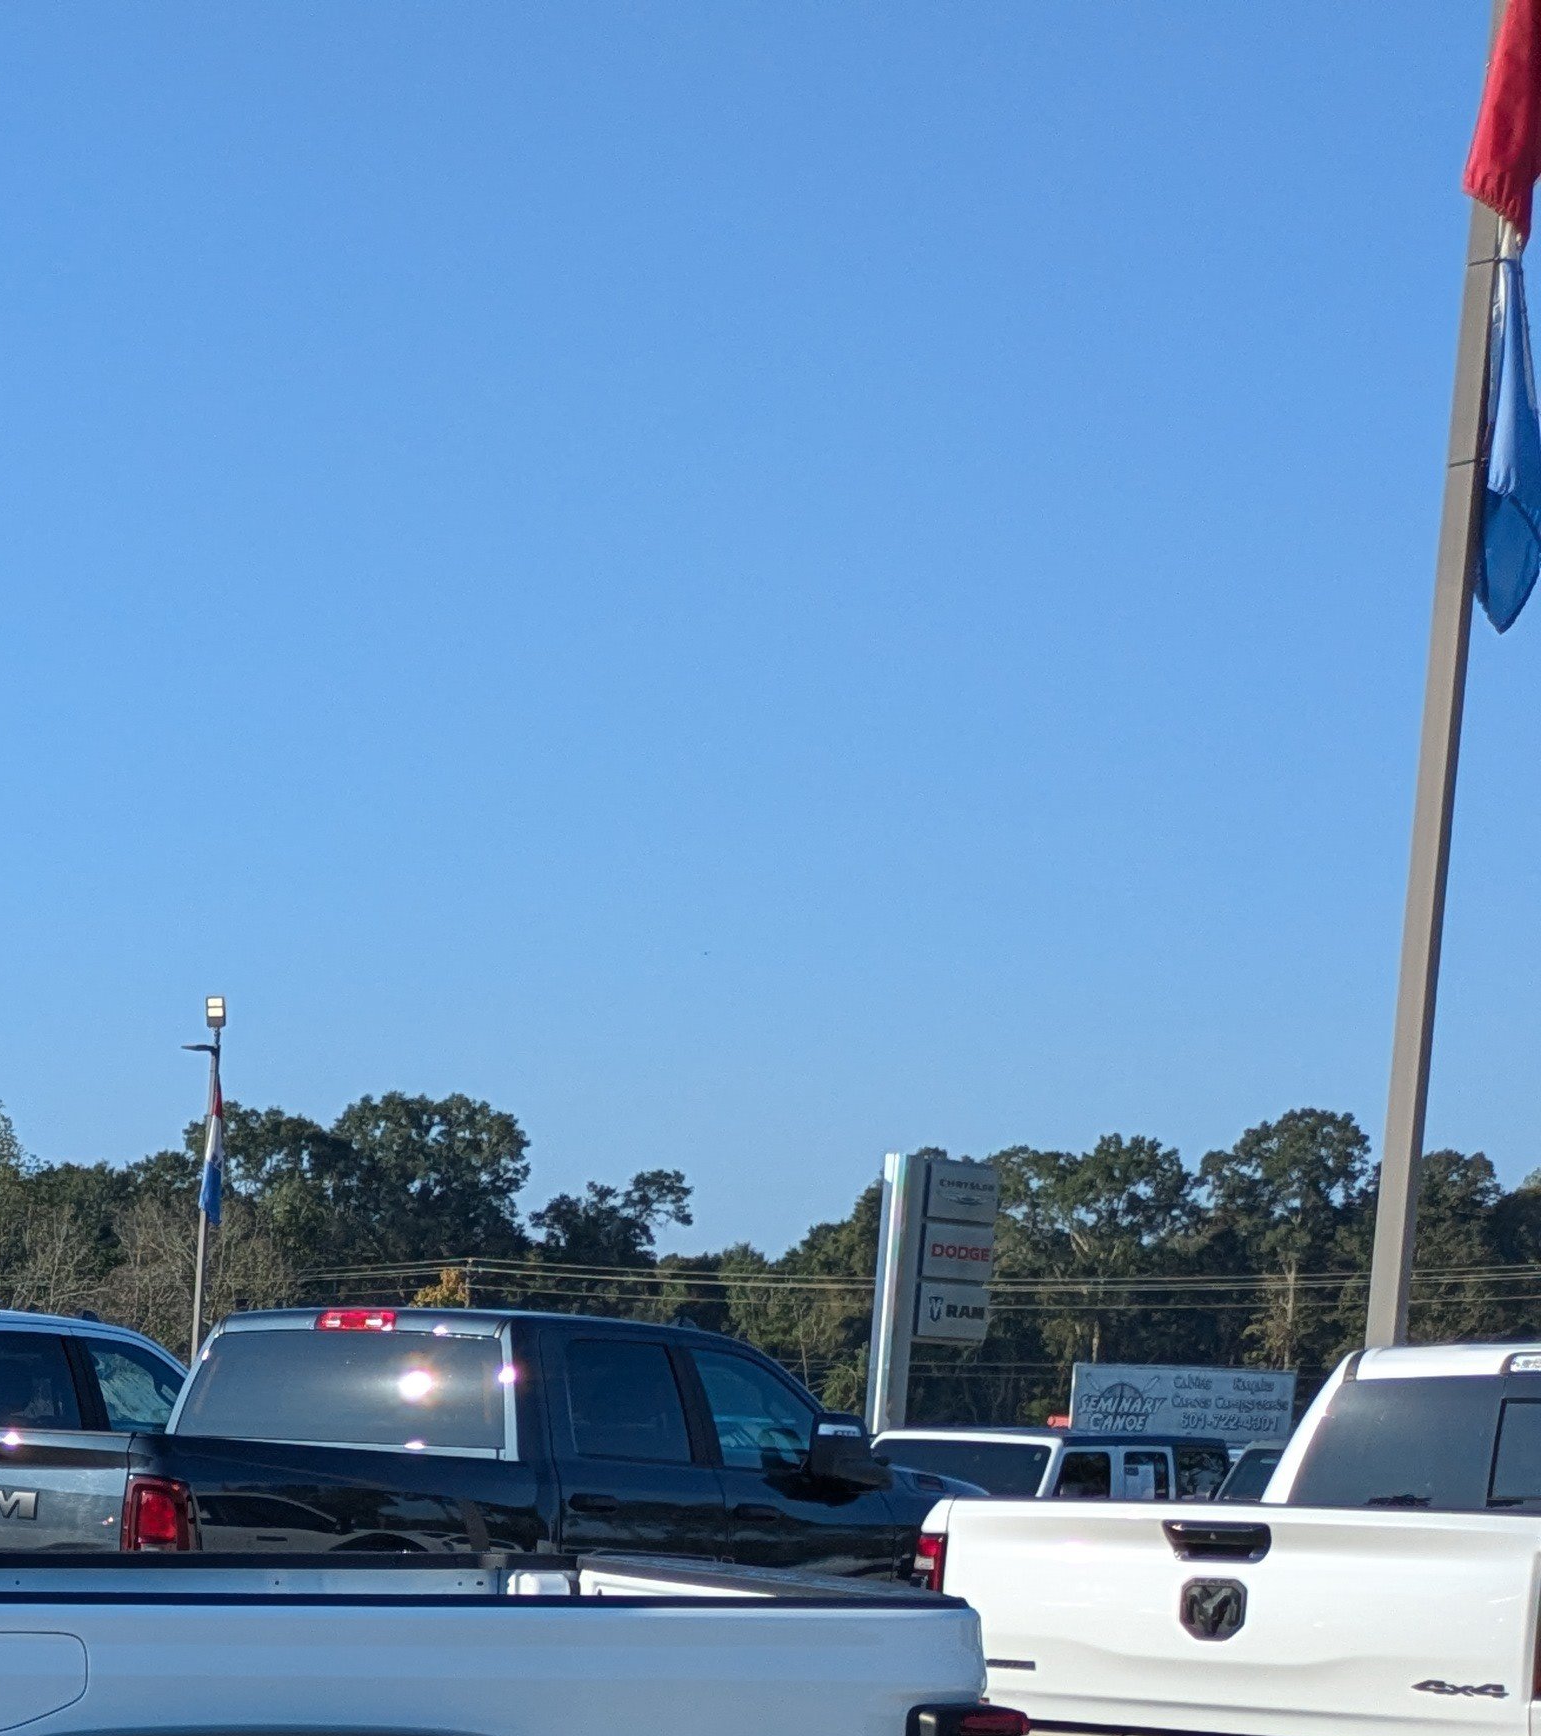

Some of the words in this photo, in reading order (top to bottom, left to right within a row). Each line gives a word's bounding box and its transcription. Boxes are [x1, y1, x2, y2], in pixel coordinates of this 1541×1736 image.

[930, 1243, 991, 1262] DODGE
[945, 1304, 986, 1320] RAM
[1078, 1392, 1167, 1415] SEMINARY
[1088, 1412, 1150, 1432] CANOE
